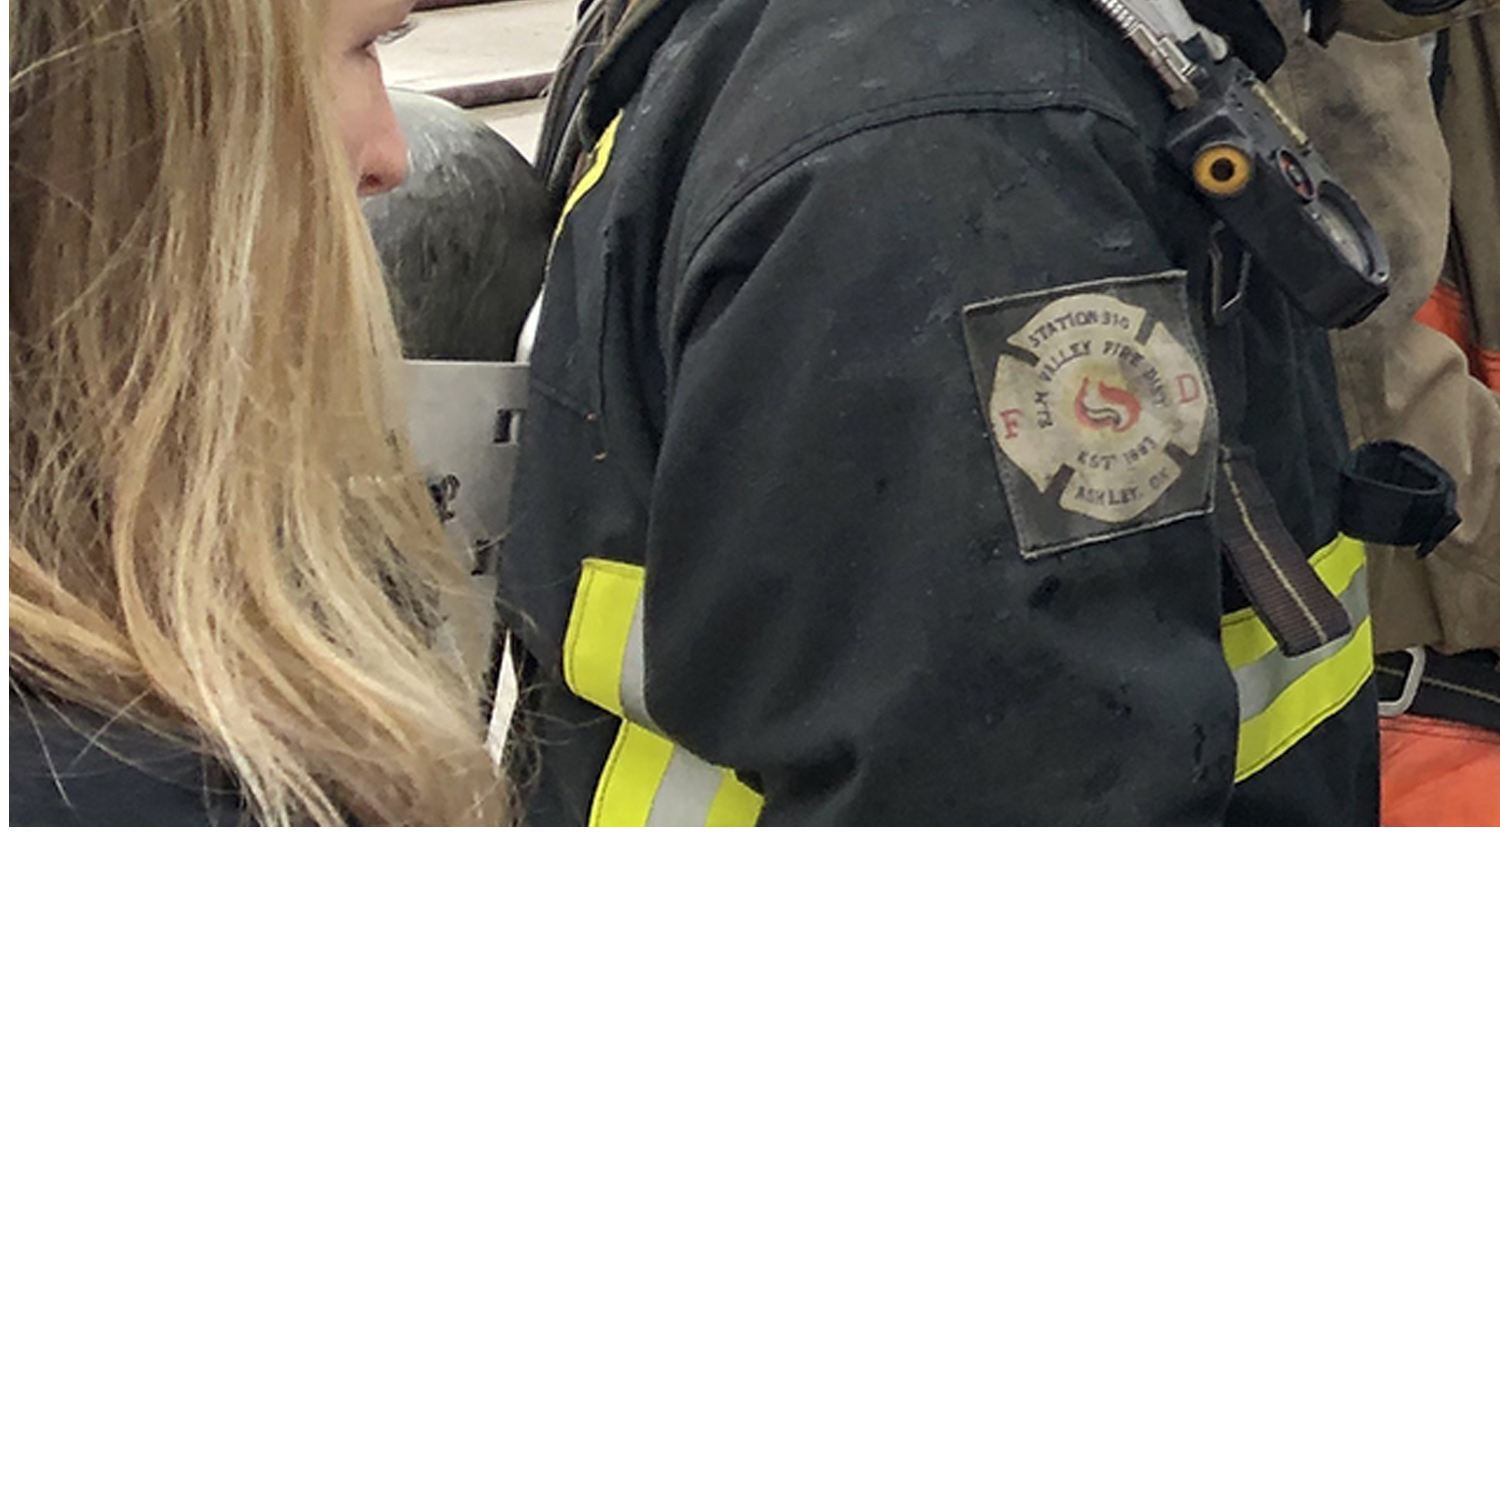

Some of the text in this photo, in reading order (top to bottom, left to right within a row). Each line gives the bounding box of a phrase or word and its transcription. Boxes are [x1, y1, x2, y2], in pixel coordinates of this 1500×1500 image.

[1028, 311, 1130, 348] STATION 310
[1103, 340, 1144, 368] FIRE
[1176, 373, 1201, 405] D
[999, 408, 1023, 440] F
[1077, 450, 1116, 470] EST
